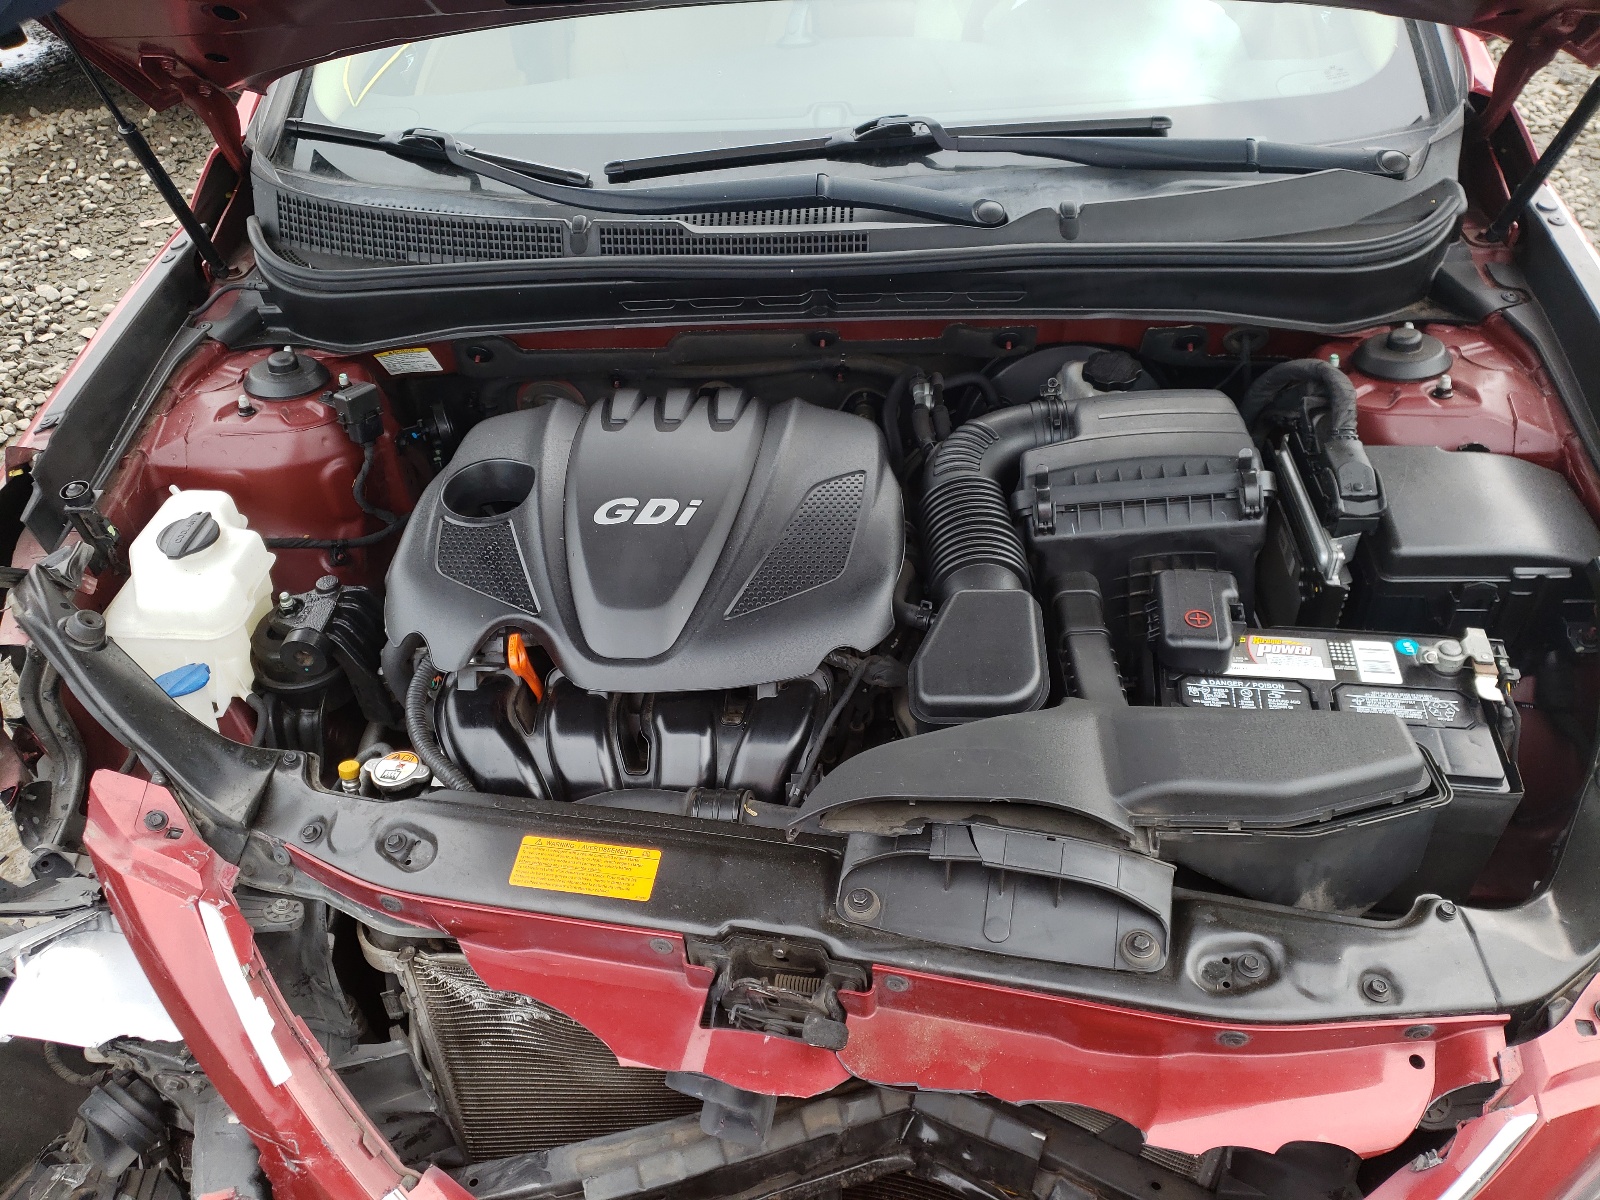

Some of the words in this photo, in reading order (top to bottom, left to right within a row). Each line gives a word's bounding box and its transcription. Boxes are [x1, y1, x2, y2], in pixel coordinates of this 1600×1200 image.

[593, 497, 703, 526] GDi
[1257, 643, 1311, 656] POWER
[1208, 679, 1244, 687] DANGER
[546, 840, 575, 849] WARNING
